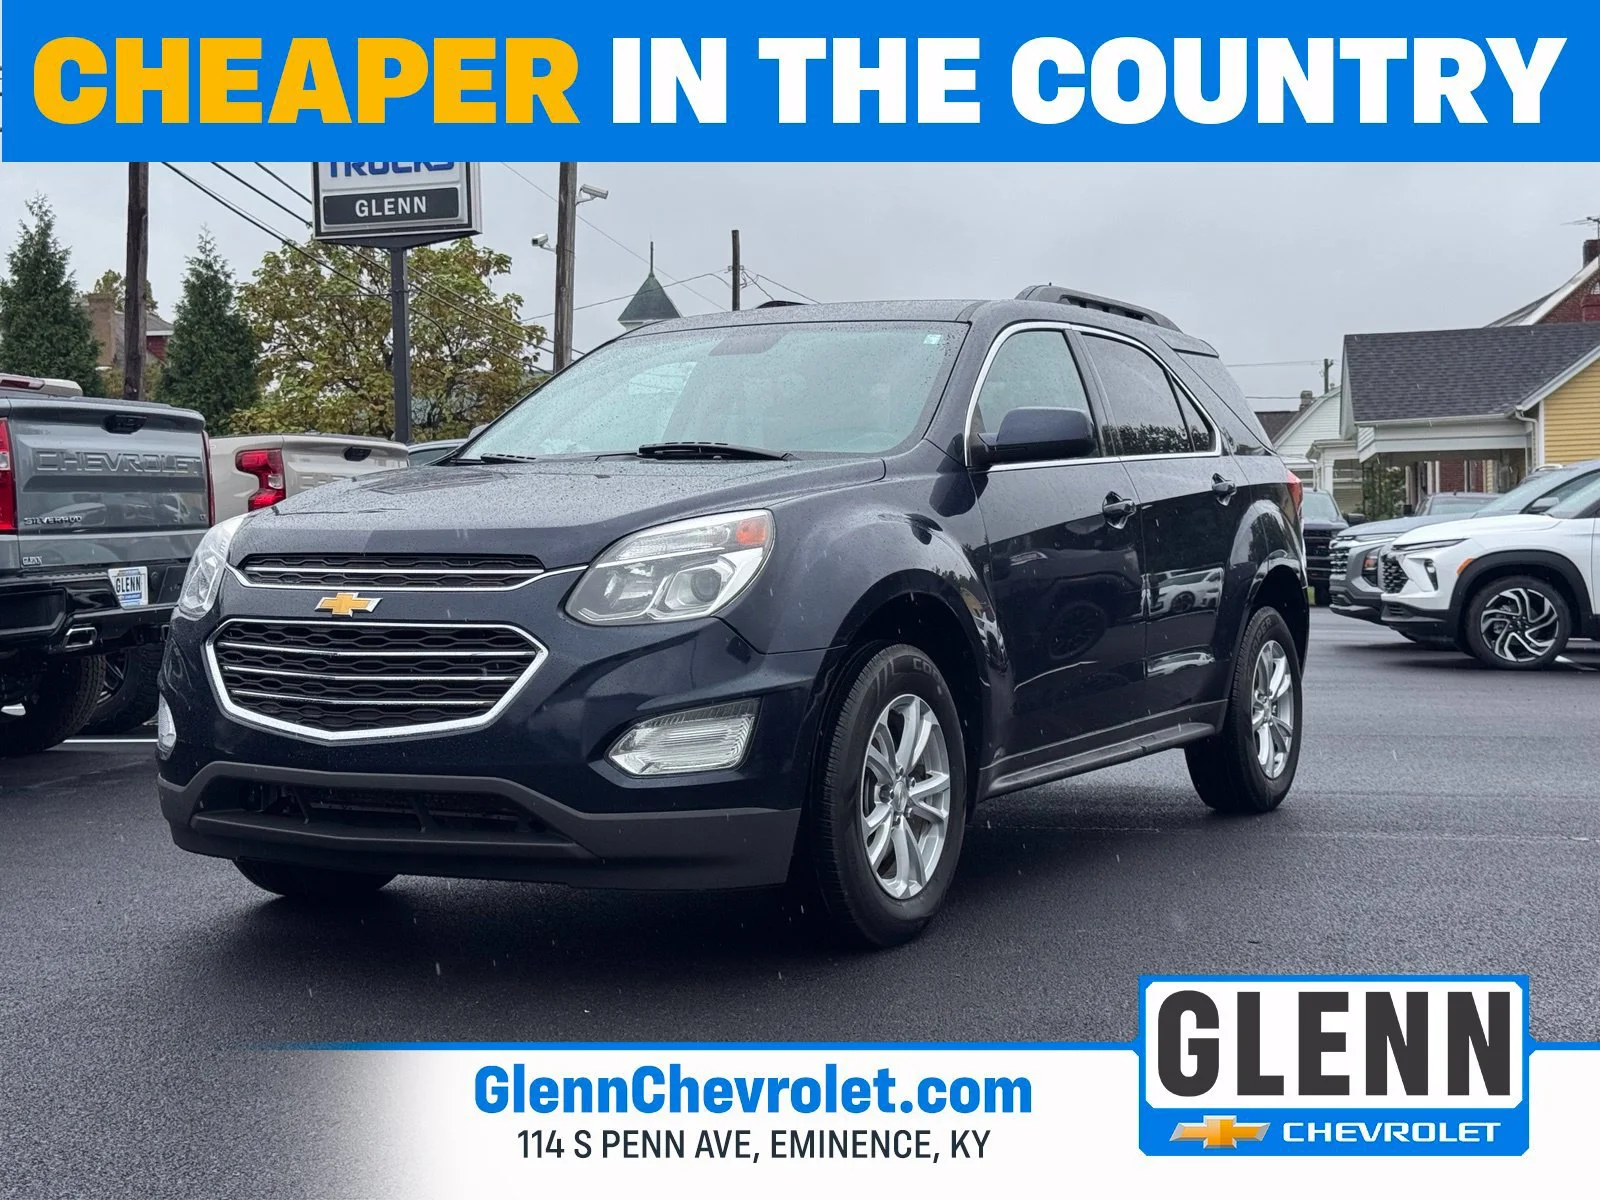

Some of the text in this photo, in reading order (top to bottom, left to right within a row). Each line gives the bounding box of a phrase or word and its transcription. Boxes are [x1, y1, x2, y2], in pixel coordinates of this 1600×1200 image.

[355, 196, 427, 217] GLENN
[34, 450, 200, 474] CHEVROLET
[115, 576, 141, 593] GLENN
